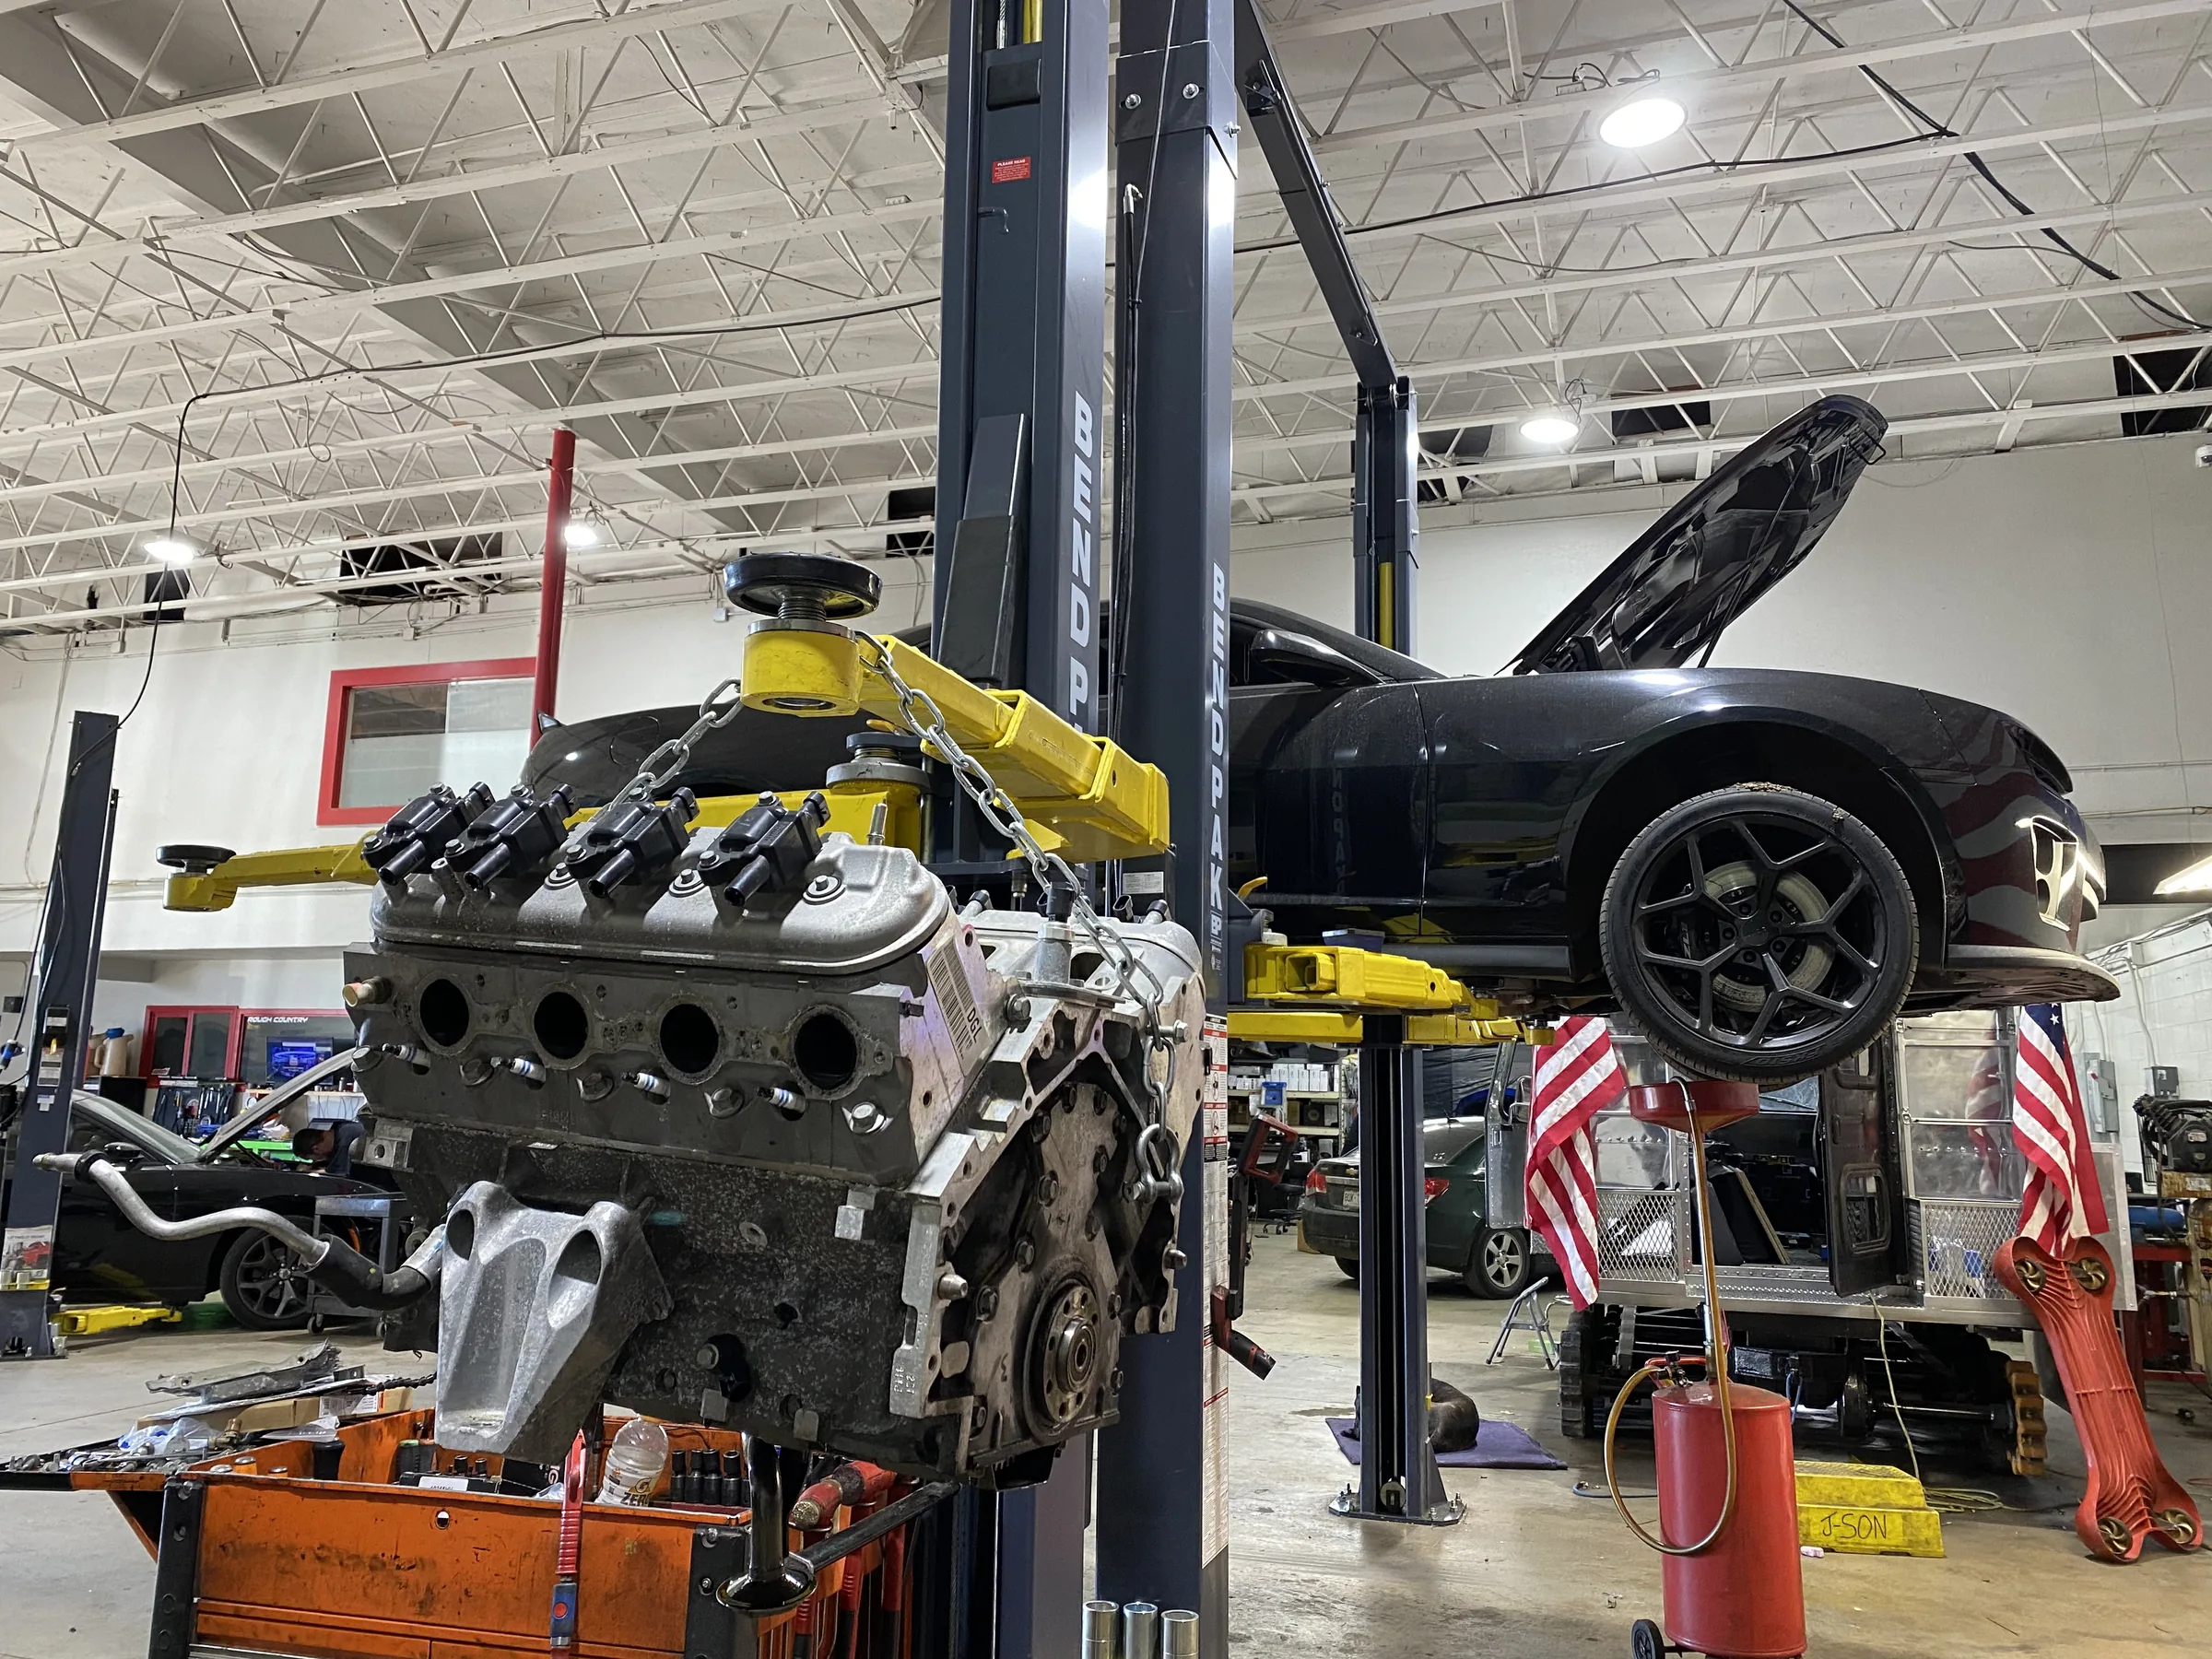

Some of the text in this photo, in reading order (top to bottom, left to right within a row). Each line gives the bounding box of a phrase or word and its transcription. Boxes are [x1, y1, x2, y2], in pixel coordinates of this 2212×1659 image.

[1070, 390, 1094, 735] BENDP
[1210, 561, 1226, 912] BENDPAK
[246, 1016, 309, 1024] ROUGH COUNTRY
[967, 1006, 982, 1043] DGL
[1820, 1512, 1887, 1539] J-SON
